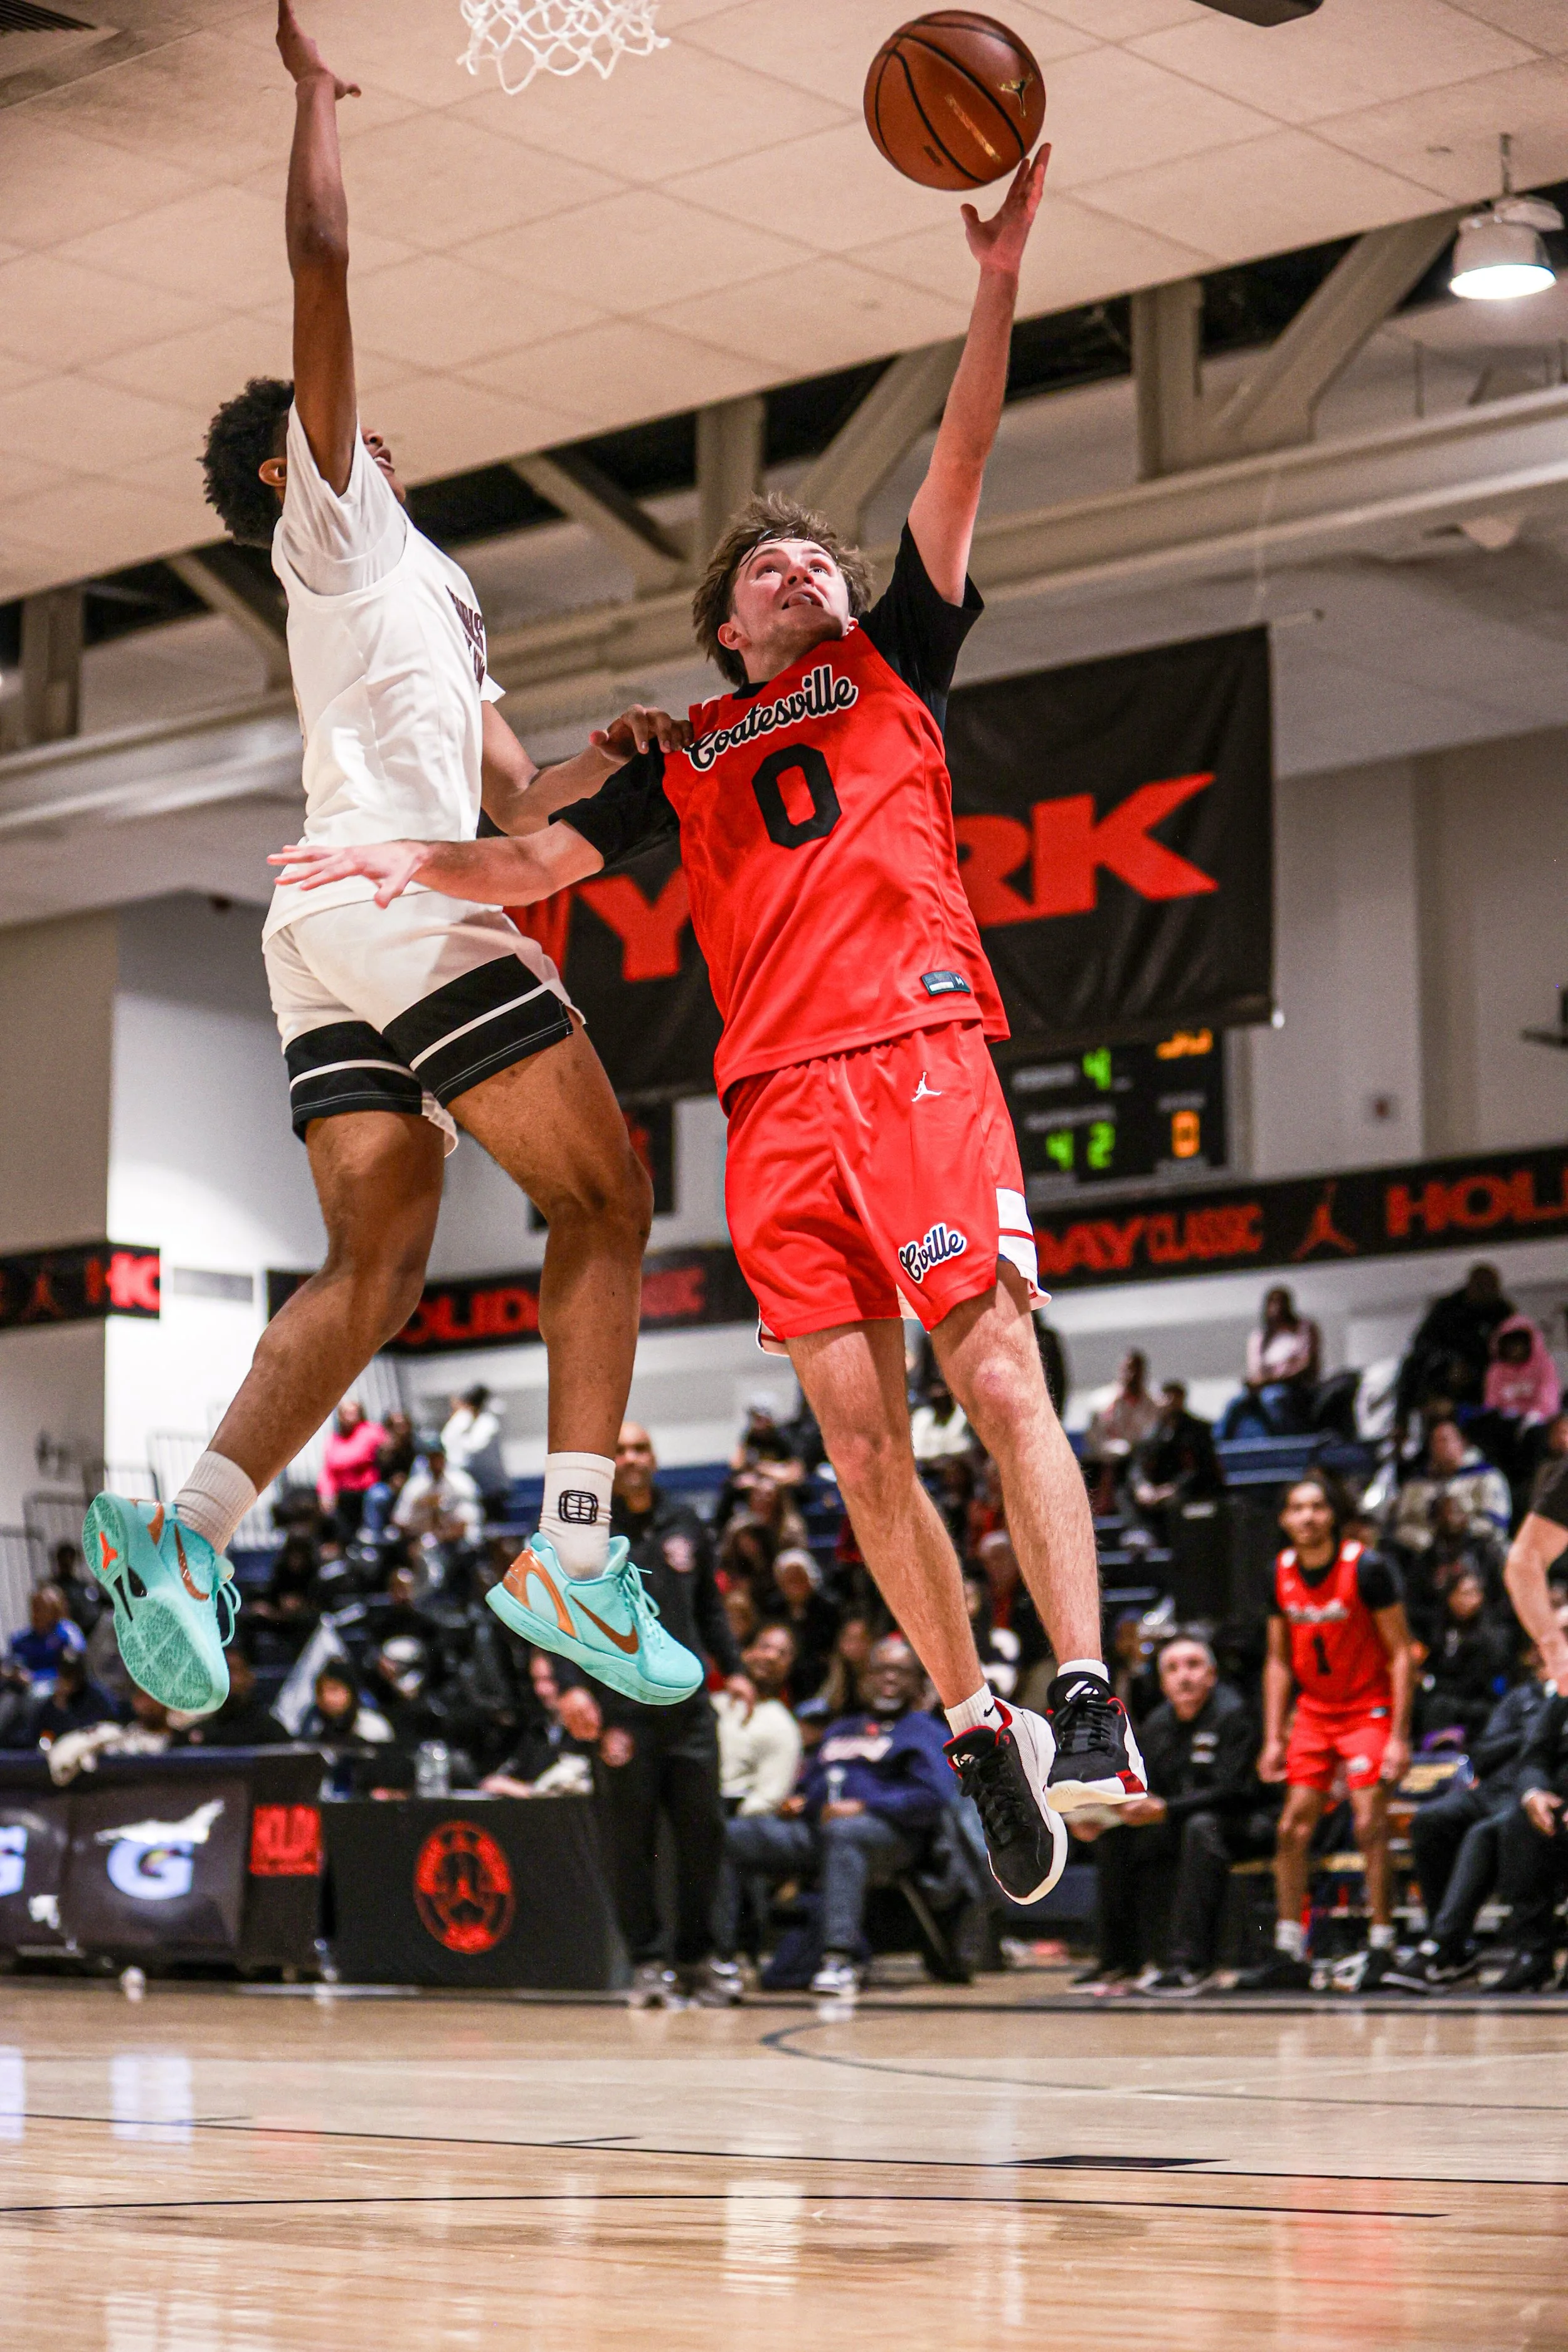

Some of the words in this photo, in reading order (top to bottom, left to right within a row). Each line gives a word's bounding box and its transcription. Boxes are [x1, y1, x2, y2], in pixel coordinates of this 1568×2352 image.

[682, 664, 858, 771] Coatesville
[752, 743, 842, 849] 0
[576, 772, 1218, 982] YRK
[898, 1222, 967, 1284] Cville
